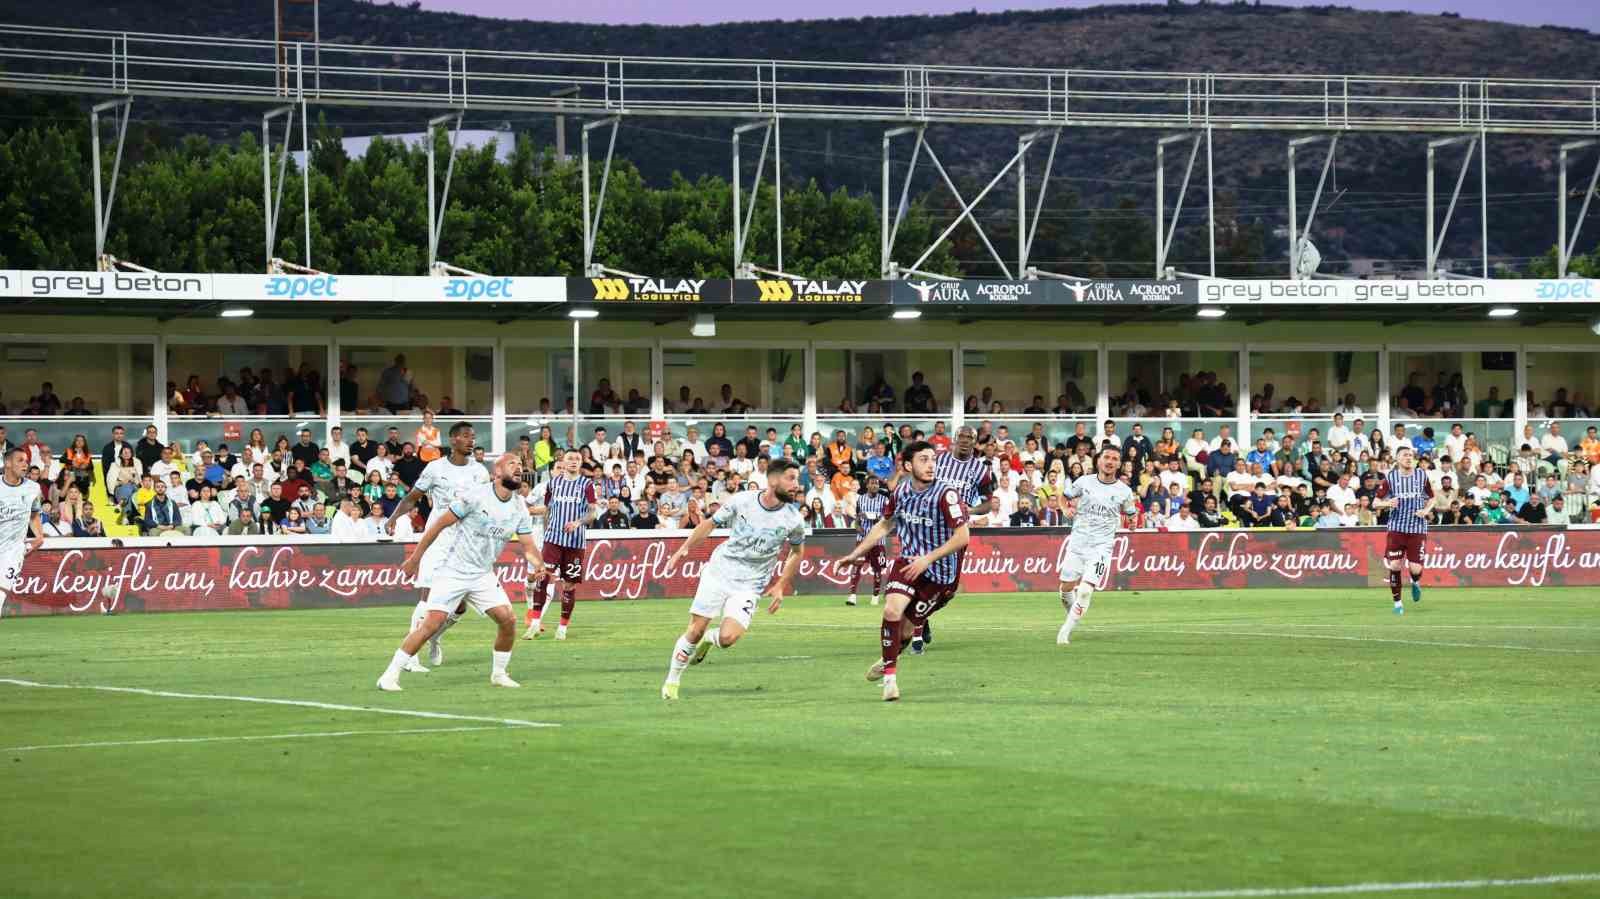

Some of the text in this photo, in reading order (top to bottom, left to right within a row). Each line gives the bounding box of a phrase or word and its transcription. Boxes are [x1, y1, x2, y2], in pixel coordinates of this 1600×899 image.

[32, 276, 104, 296] grey
[114, 273, 201, 292] beton
[268, 276, 337, 299] opet
[446, 277, 512, 300] opet
[629, 278, 706, 294] TALAY
[792, 280, 868, 295] TALAY
[940, 282, 960, 290] GRUP
[976, 283, 1031, 295] ACROPOL
[1129, 284, 1183, 295] ACROPOL
[1206, 282, 1338, 300] grey beton
[1354, 282, 1486, 300] grey beton
[932, 289, 970, 301] AURA
[1086, 289, 1124, 301] AURA
[1024, 557, 1053, 573] en
[1196, 532, 1267, 571] kahve
[1269, 552, 1358, 579] zamanı
[1464, 552, 1492, 569] en
[1494, 531, 1576, 587] keyifli
[566, 563, 581, 576] 22
[585, 540, 678, 599] keyifli
[1093, 561, 1105, 575] 10
[13, 576, 49, 594] en
[53, 550, 158, 611] keyifli
[228, 547, 316, 590] kahve
